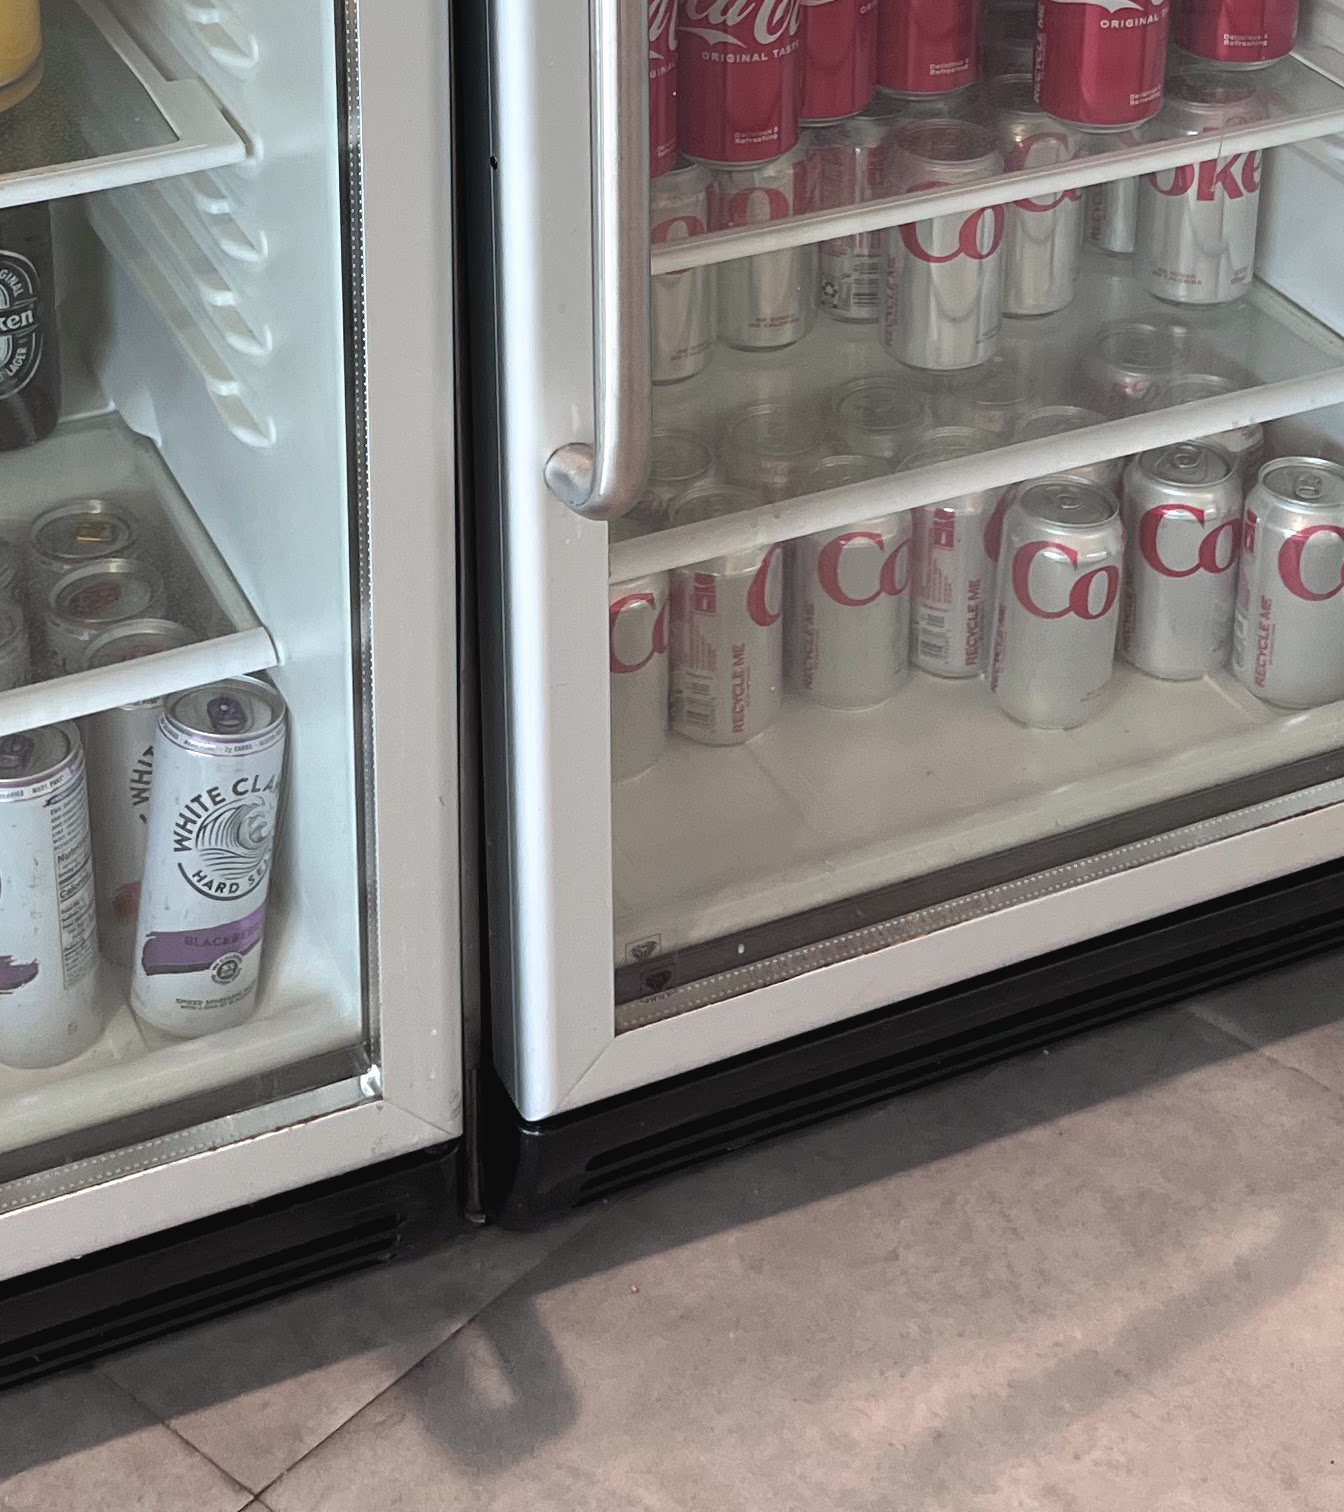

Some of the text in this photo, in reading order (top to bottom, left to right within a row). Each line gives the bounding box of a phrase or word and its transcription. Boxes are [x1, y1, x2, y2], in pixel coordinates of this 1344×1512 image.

[1100, 15, 1159, 29] ORIGINAL
[701, 51, 768, 63] ORIGINAL
[6, 346, 27, 377] LAGER
[964, 577, 982, 667] RECYCLE ME
[1254, 595, 1272, 688] RECYCLE ME
[731, 643, 746, 734] RECYCLE ME
[173, 786, 227, 853] WHITE
[191, 870, 240, 894] HARD
